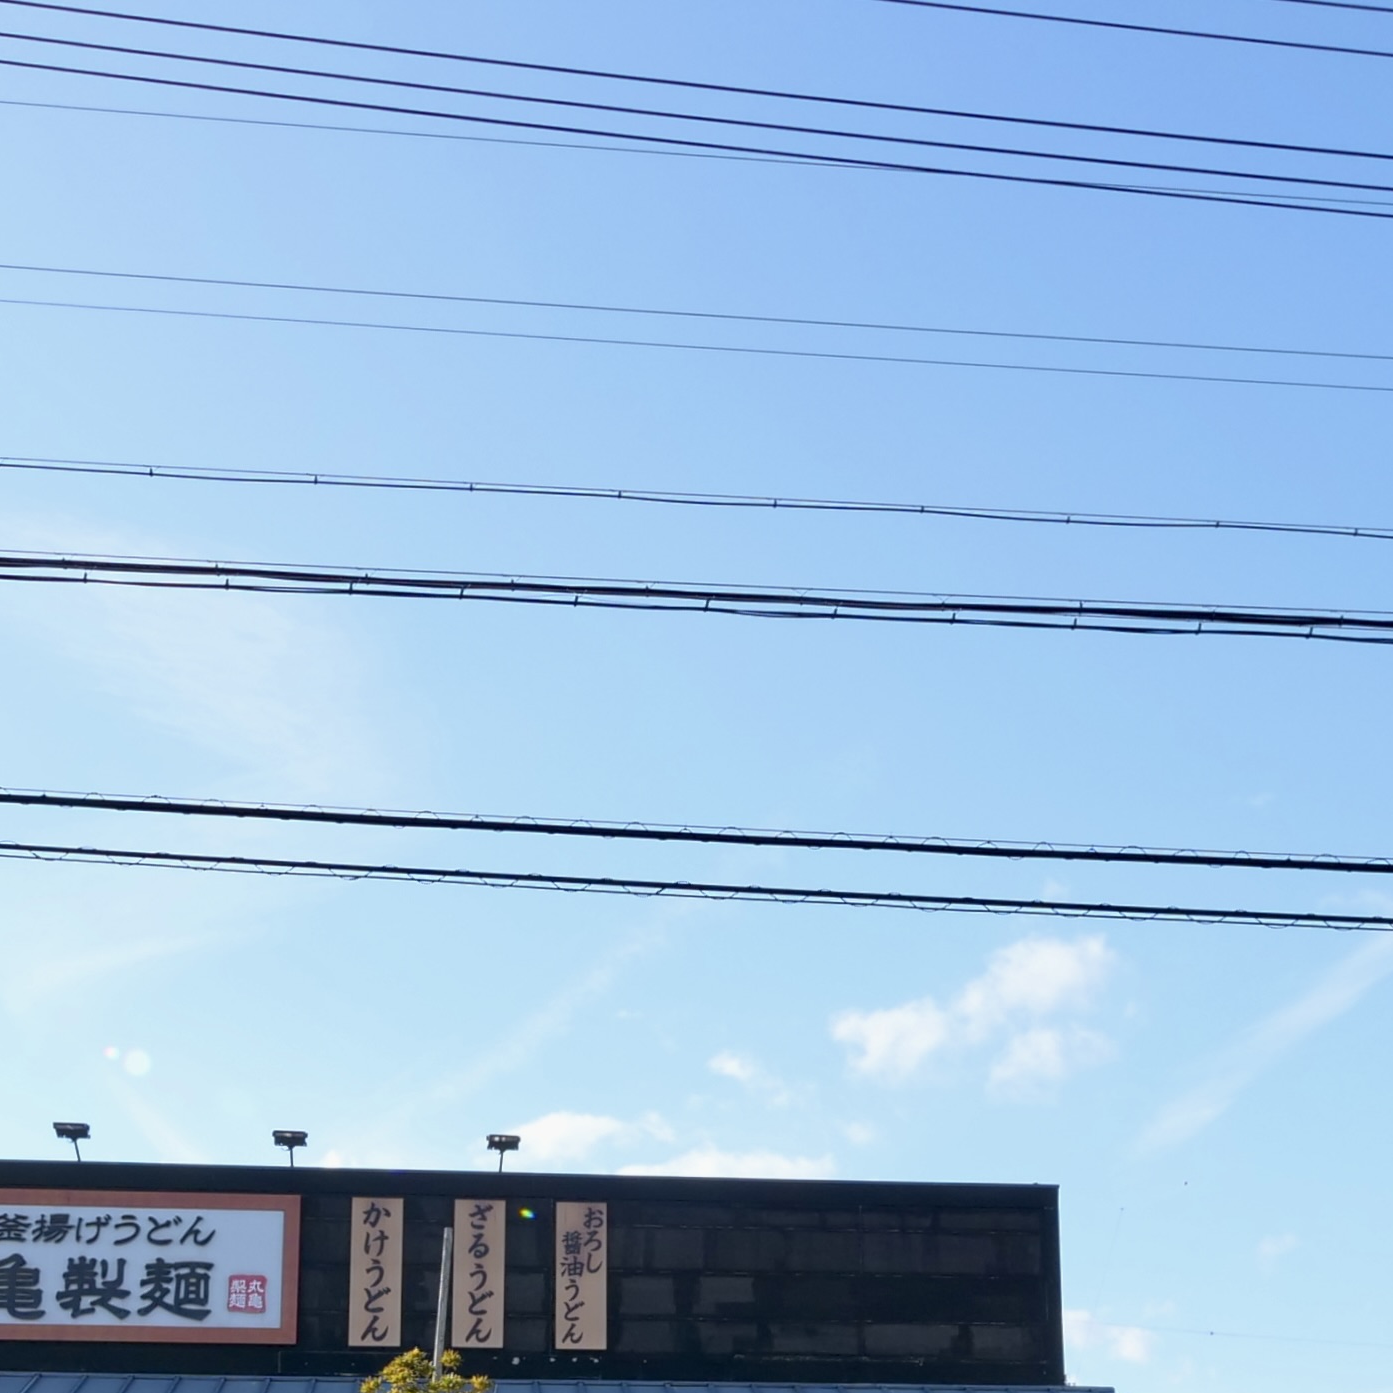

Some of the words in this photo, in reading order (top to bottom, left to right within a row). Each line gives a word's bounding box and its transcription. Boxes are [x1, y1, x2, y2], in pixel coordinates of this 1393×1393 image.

[360, 1202, 392, 1343] かけうどん
[465, 1203, 495, 1344] ざるうどん
[560, 1230, 586, 1345] 醤油うどん
[582, 1207, 604, 1274] おろし
